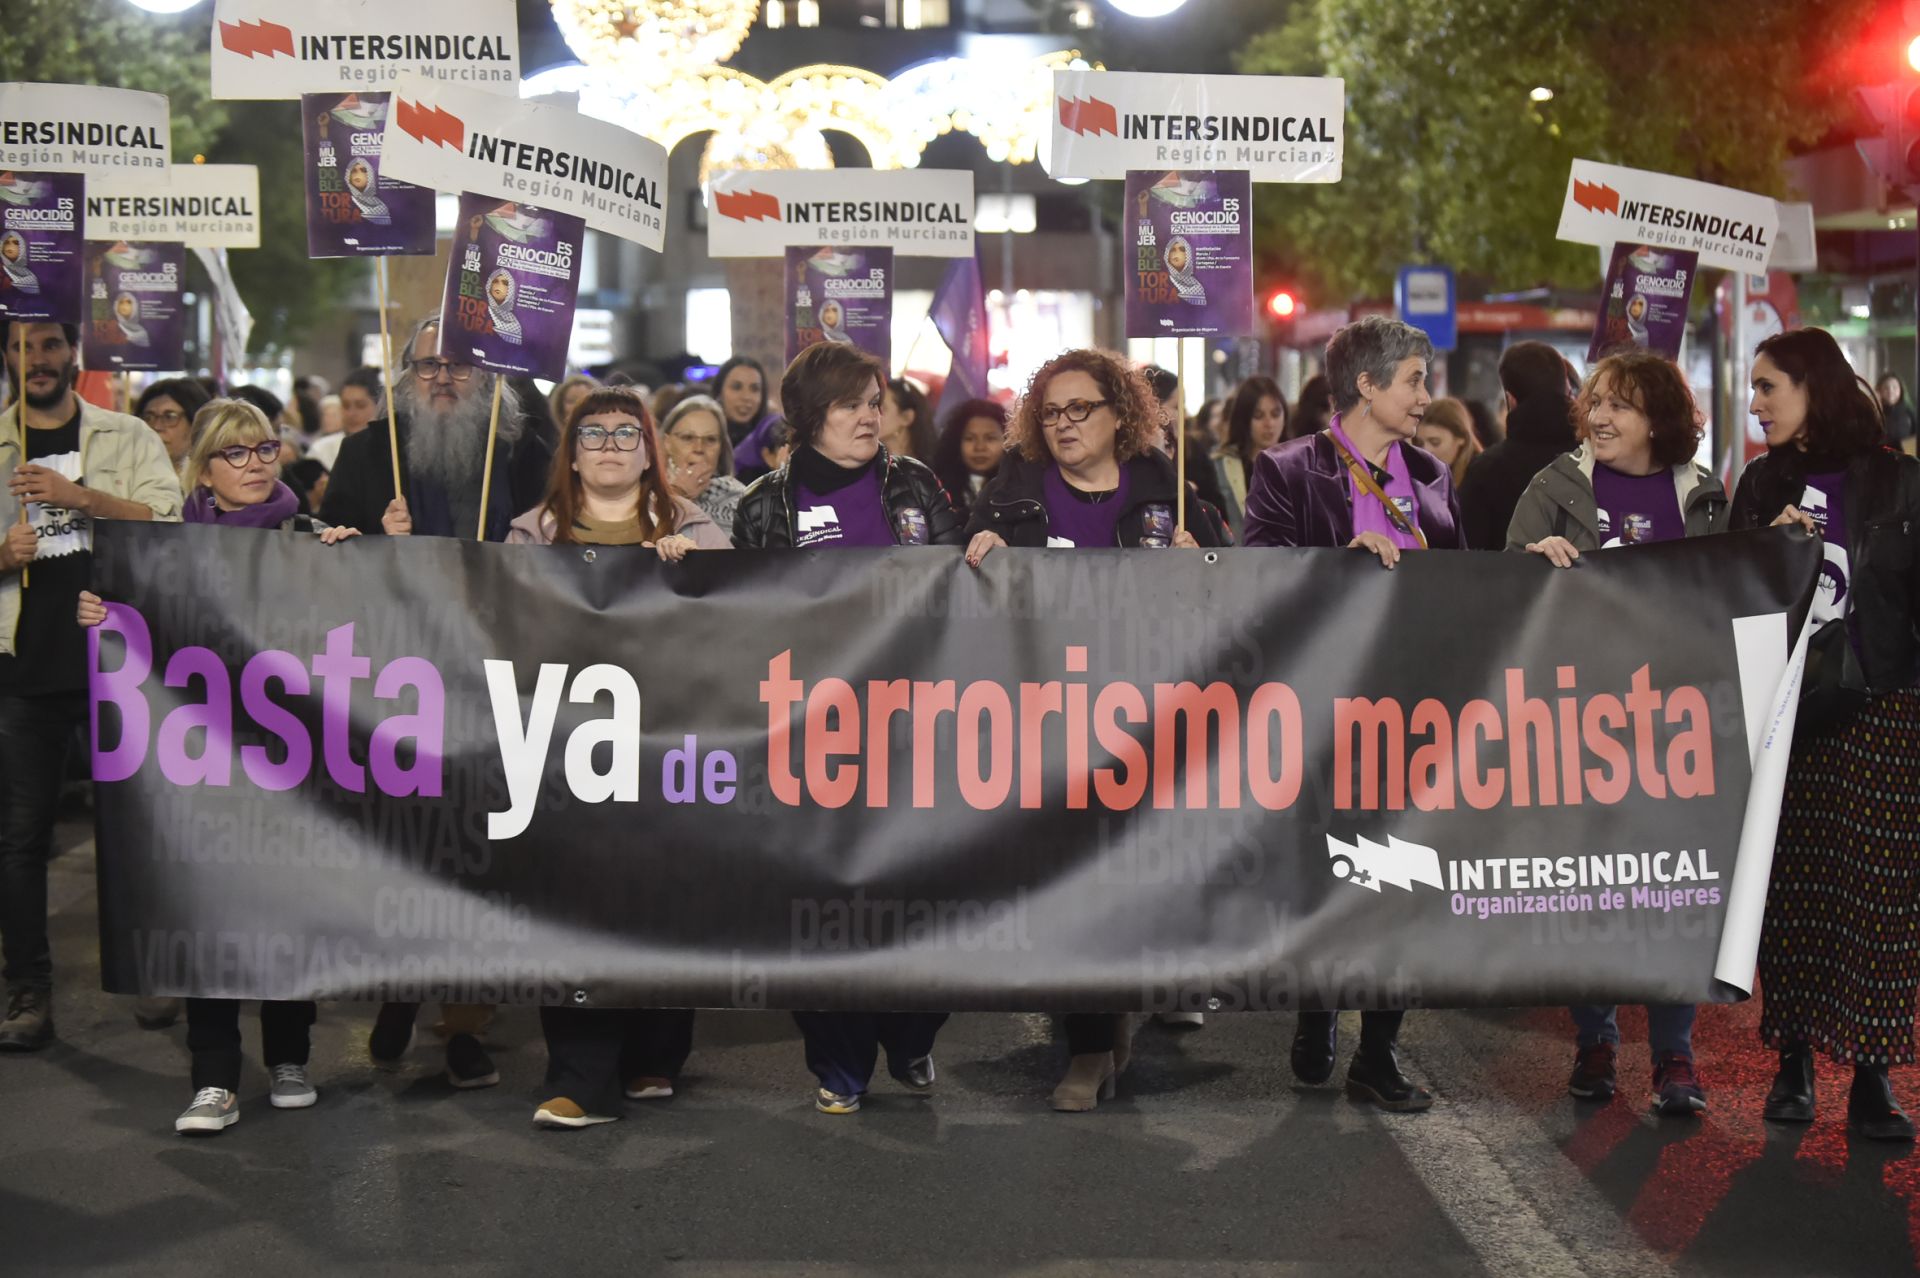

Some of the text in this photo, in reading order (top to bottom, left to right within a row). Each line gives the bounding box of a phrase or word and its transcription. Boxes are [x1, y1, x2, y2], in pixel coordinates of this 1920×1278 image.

[301, 35, 511, 61] INTERSINDICAL
[340, 63, 512, 83] Regió Murciana
[0, 121, 164, 150] ERSINDICAL
[1123, 114, 1334, 142] INTERSINDICAL
[73, 150, 164, 168] Murciana
[318, 157, 336, 167] JER
[1157, 145, 1335, 164] Región Murciana
[469, 132, 662, 210] INTERSINDICAL
[58, 198, 74, 209] ES
[88, 197, 253, 217] NTERSINDICAL
[320, 193, 350, 208] TOR
[503, 172, 661, 230] Región Murciana
[1223, 198, 1239, 210] ES
[5, 209, 73, 221] GENOCIDIO
[786, 202, 967, 223] INTERSINDICAL
[1171, 211, 1239, 224] GENOCIDIO
[109, 219, 253, 235] Región Murciana
[1139, 226, 1154, 236] MU
[1621, 200, 1767, 247] INTERSINDICAL
[819, 226, 968, 242] Región Murciana
[1137, 236, 1156, 246] JER
[557, 241, 573, 256] ES
[1637, 226, 1764, 262] Región Murciana
[465, 250, 480, 261] MU
[499, 243, 571, 269] GENOCIDIO
[1138, 247, 1157, 258] DO
[462, 261, 481, 272] JER
[1138, 259, 1161, 271] BLE
[118, 272, 177, 283] GENOCIDIO
[870, 268, 884, 279] ES
[1138, 272, 1168, 287] TOR
[1636, 274, 1685, 289] GENOCIDIO
[460, 283, 483, 297] BLE
[824, 279, 884, 289] GENOCIDIO
[1138, 288, 1179, 304] TURA
[458, 296, 488, 318] TOR
[87, 600, 446, 798] Basta
[483, 659, 641, 840] ya
[662, 734, 737, 804] de
[759, 645, 1303, 811] terrorismo
[1450, 848, 1719, 890] INTERSINDICAL
[1450, 884, 1721, 919] Organización de Mujeres
